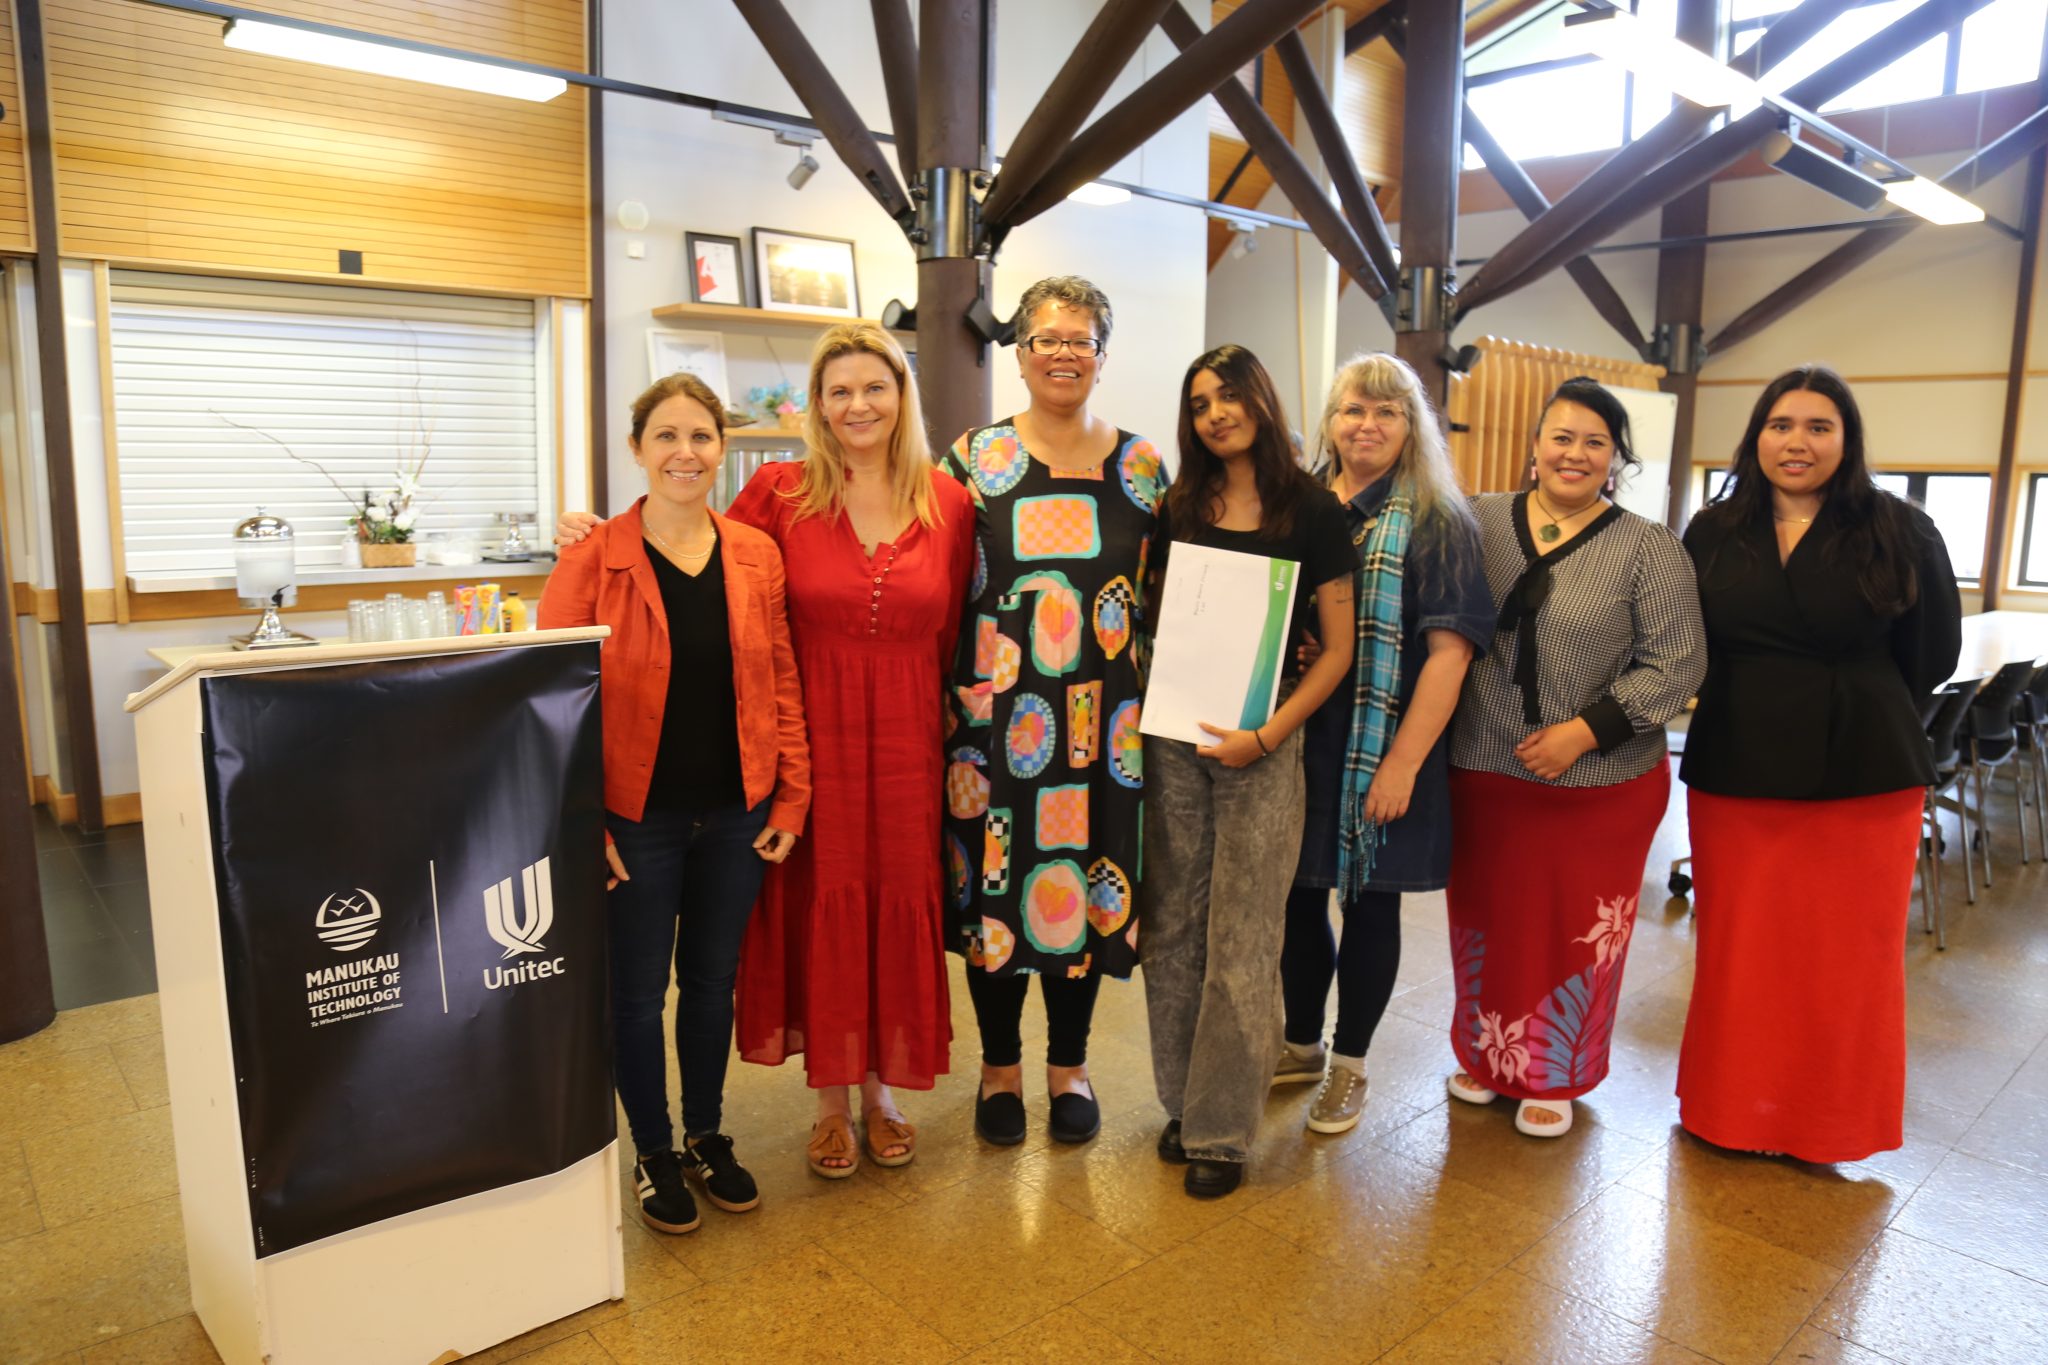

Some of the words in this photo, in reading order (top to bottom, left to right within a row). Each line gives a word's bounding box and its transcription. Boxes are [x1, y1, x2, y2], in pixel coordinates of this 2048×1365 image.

[306, 953, 399, 988] MANUKAU
[483, 956, 565, 990] Unitec
[307, 976, 378, 1003] INSTITUTE
[382, 972, 400, 986] OF
[309, 986, 402, 1018] TECHNOLOGY
